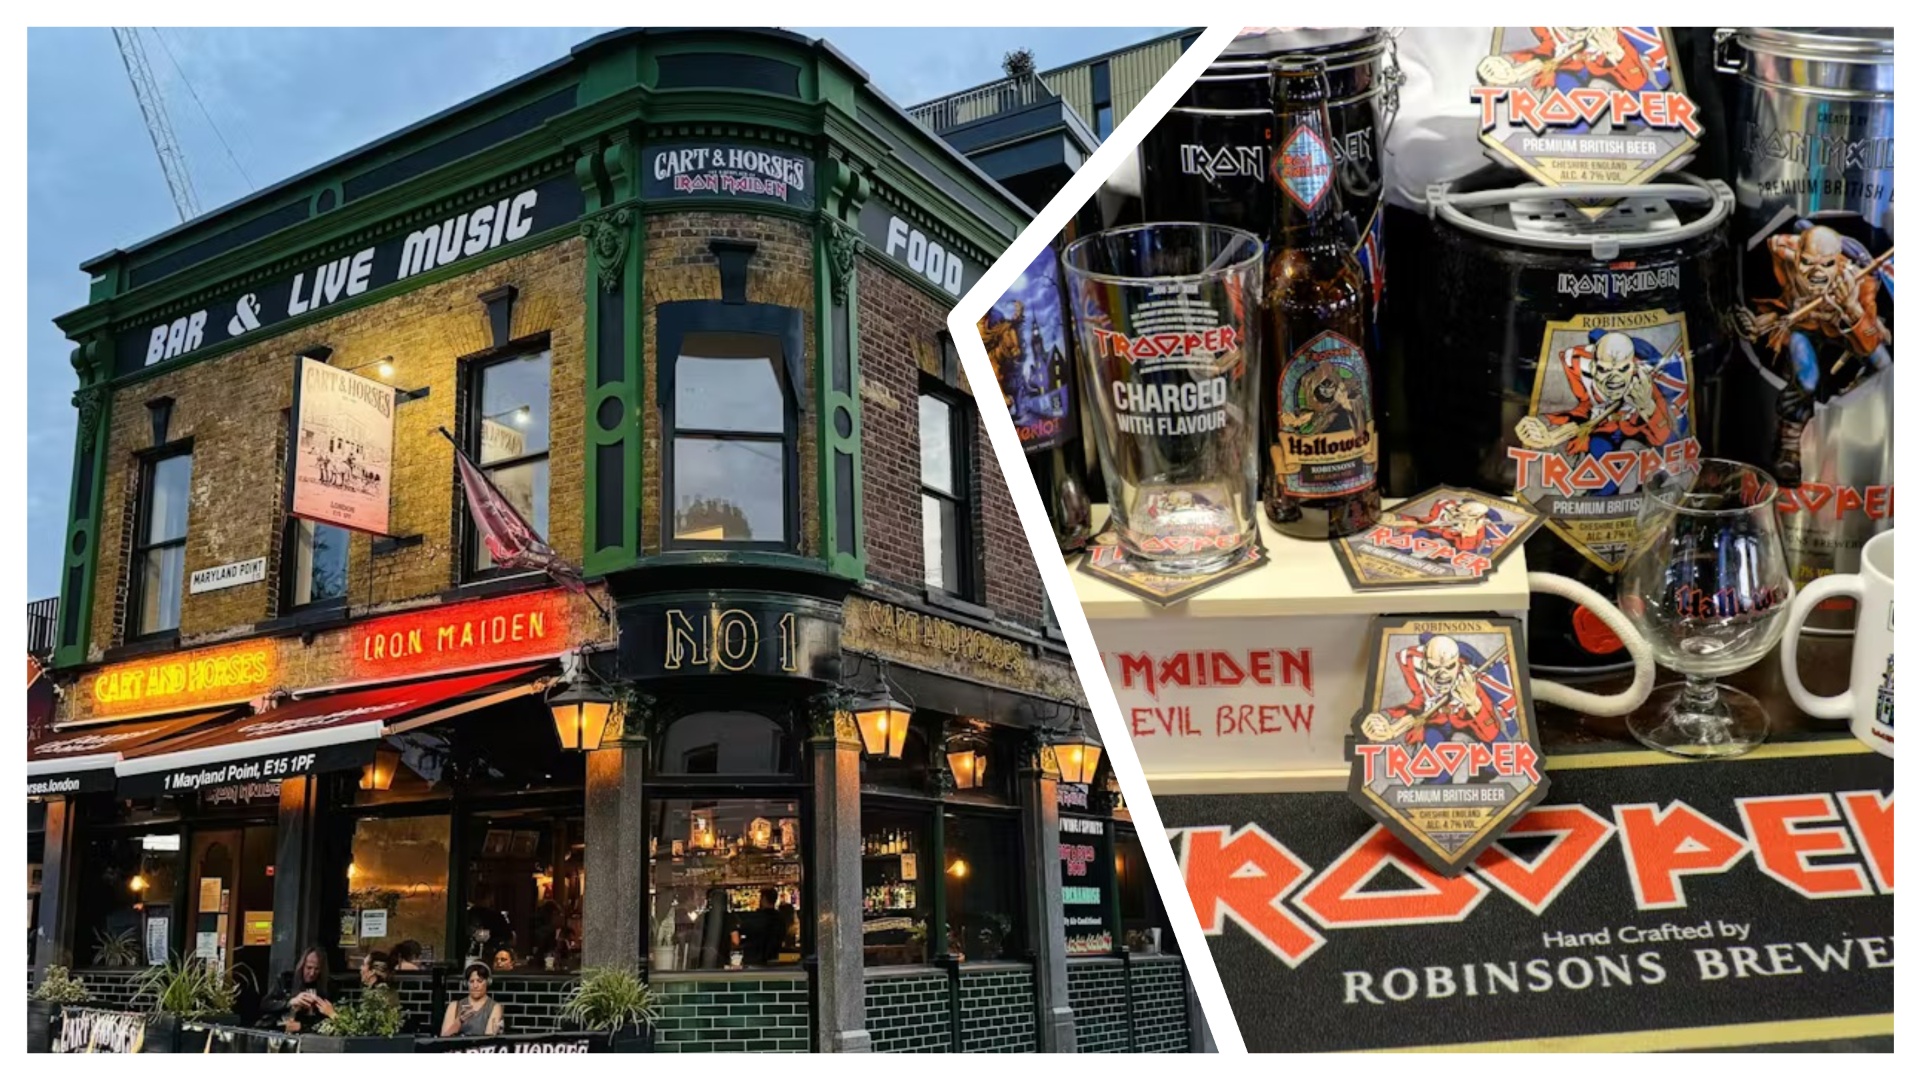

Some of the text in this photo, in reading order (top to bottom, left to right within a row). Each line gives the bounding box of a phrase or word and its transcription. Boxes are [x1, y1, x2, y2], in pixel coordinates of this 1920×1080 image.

[1470, 85, 1704, 137] TROOPER
[1181, 144, 1265, 184] IRON
[1523, 137, 1657, 155] PREMIUM BRITISH BEER
[654, 148, 804, 192] CART & HORSES
[1591, 161, 1627, 171] ENGLAND
[674, 174, 787, 202] IRON MAIDEN
[1758, 179, 1884, 198] PREMIUM BRITISH
[885, 215, 964, 296] FOOD
[145, 188, 538, 366] BAR & LIVE MUSIC
[1557, 266, 1680, 298] IRON MAIDEN
[1582, 312, 1659, 328] ROBINSONS
[1093, 325, 1239, 365] TROOPER
[306, 366, 339, 393] CART
[348, 376, 391, 418] HORSES
[1112, 377, 1227, 413] CHARGED
[1116, 411, 1227, 436] WITH FLAVOUR
[1288, 430, 1370, 456] Hallowed
[1311, 461, 1356, 474] ROBINSONS
[1507, 436, 1703, 498] TROOPER
[1553, 500, 1605, 514] PREMIUM
[193, 561, 263, 585] MARYLAND POINT
[363, 611, 545, 661] IRON MAIDEN
[664, 609, 798, 672] NO 1
[869, 600, 1025, 677] CART AND HORSES
[1413, 622, 1482, 633] ROBINSONS
[94, 651, 268, 703] CART AND HORSES
[1112, 648, 1314, 702] MAIDEN
[1131, 703, 1315, 738] EVIL BREW
[164, 753, 316, 790] 1 Maryland Point, E15 1PF
[1355, 742, 1541, 787] TROOPER
[1397, 788, 1505, 803] PREMIUM BRITISH BEER
[1543, 920, 1750, 949] Hand Crafted by
[1343, 936, 1894, 1004] ROBINSONS BREWE
